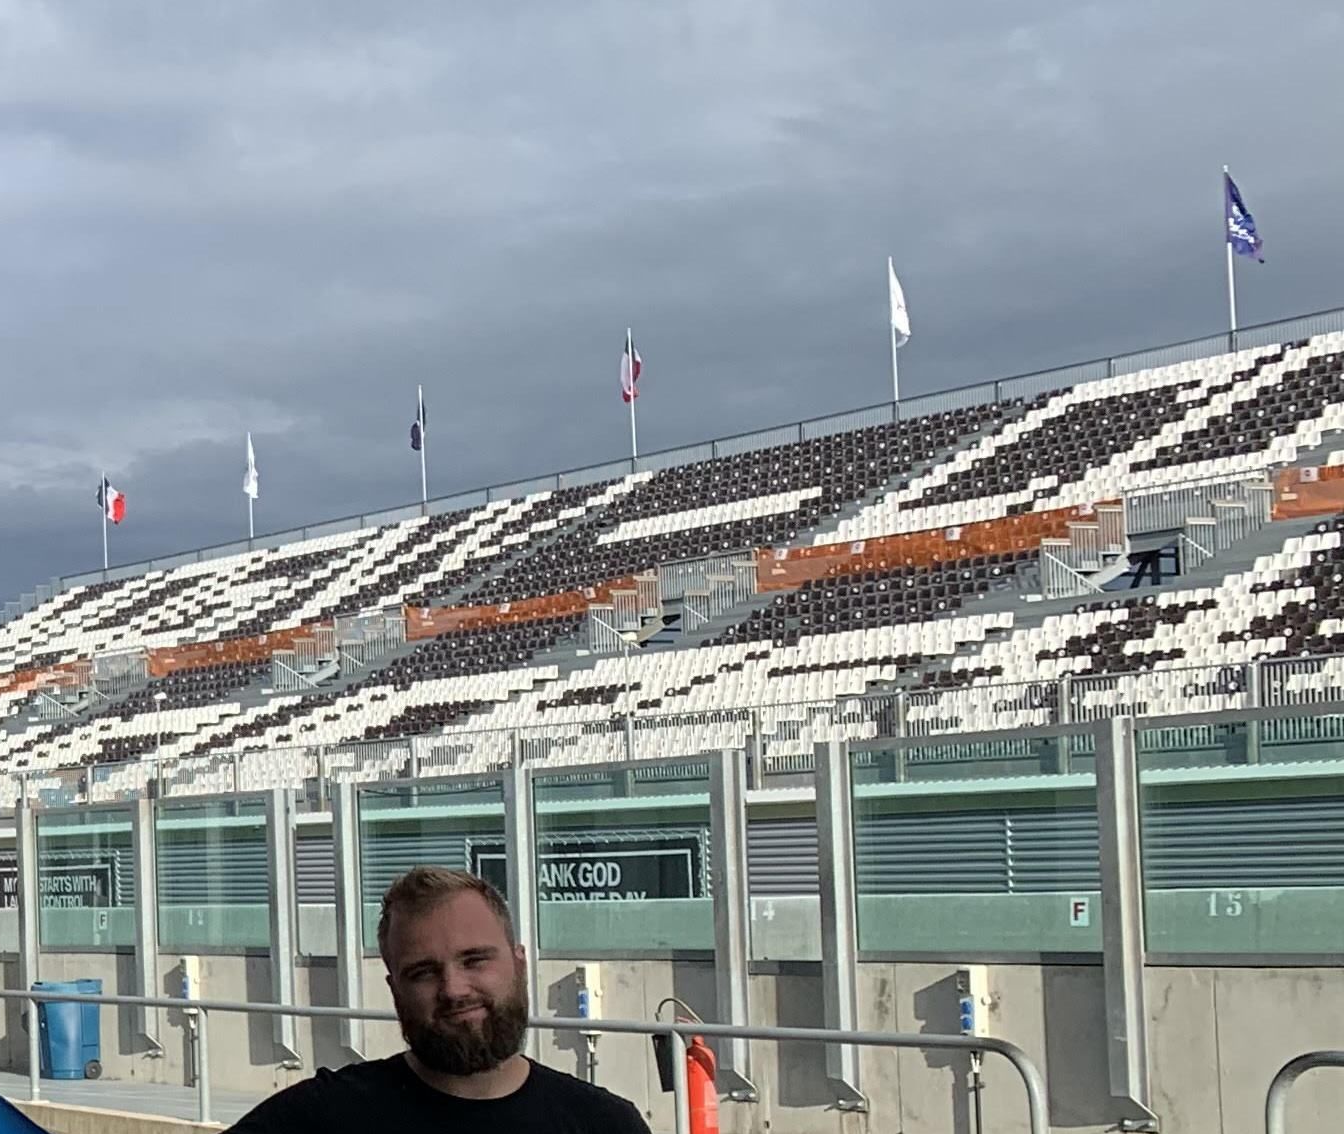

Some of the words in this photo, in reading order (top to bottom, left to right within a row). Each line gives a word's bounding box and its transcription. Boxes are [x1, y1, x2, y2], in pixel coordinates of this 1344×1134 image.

[72, 875, 97, 892] WITH
[578, 861, 621, 888] GOD
[1073, 902, 1085, 921] F
[1207, 892, 1242, 917] 15
